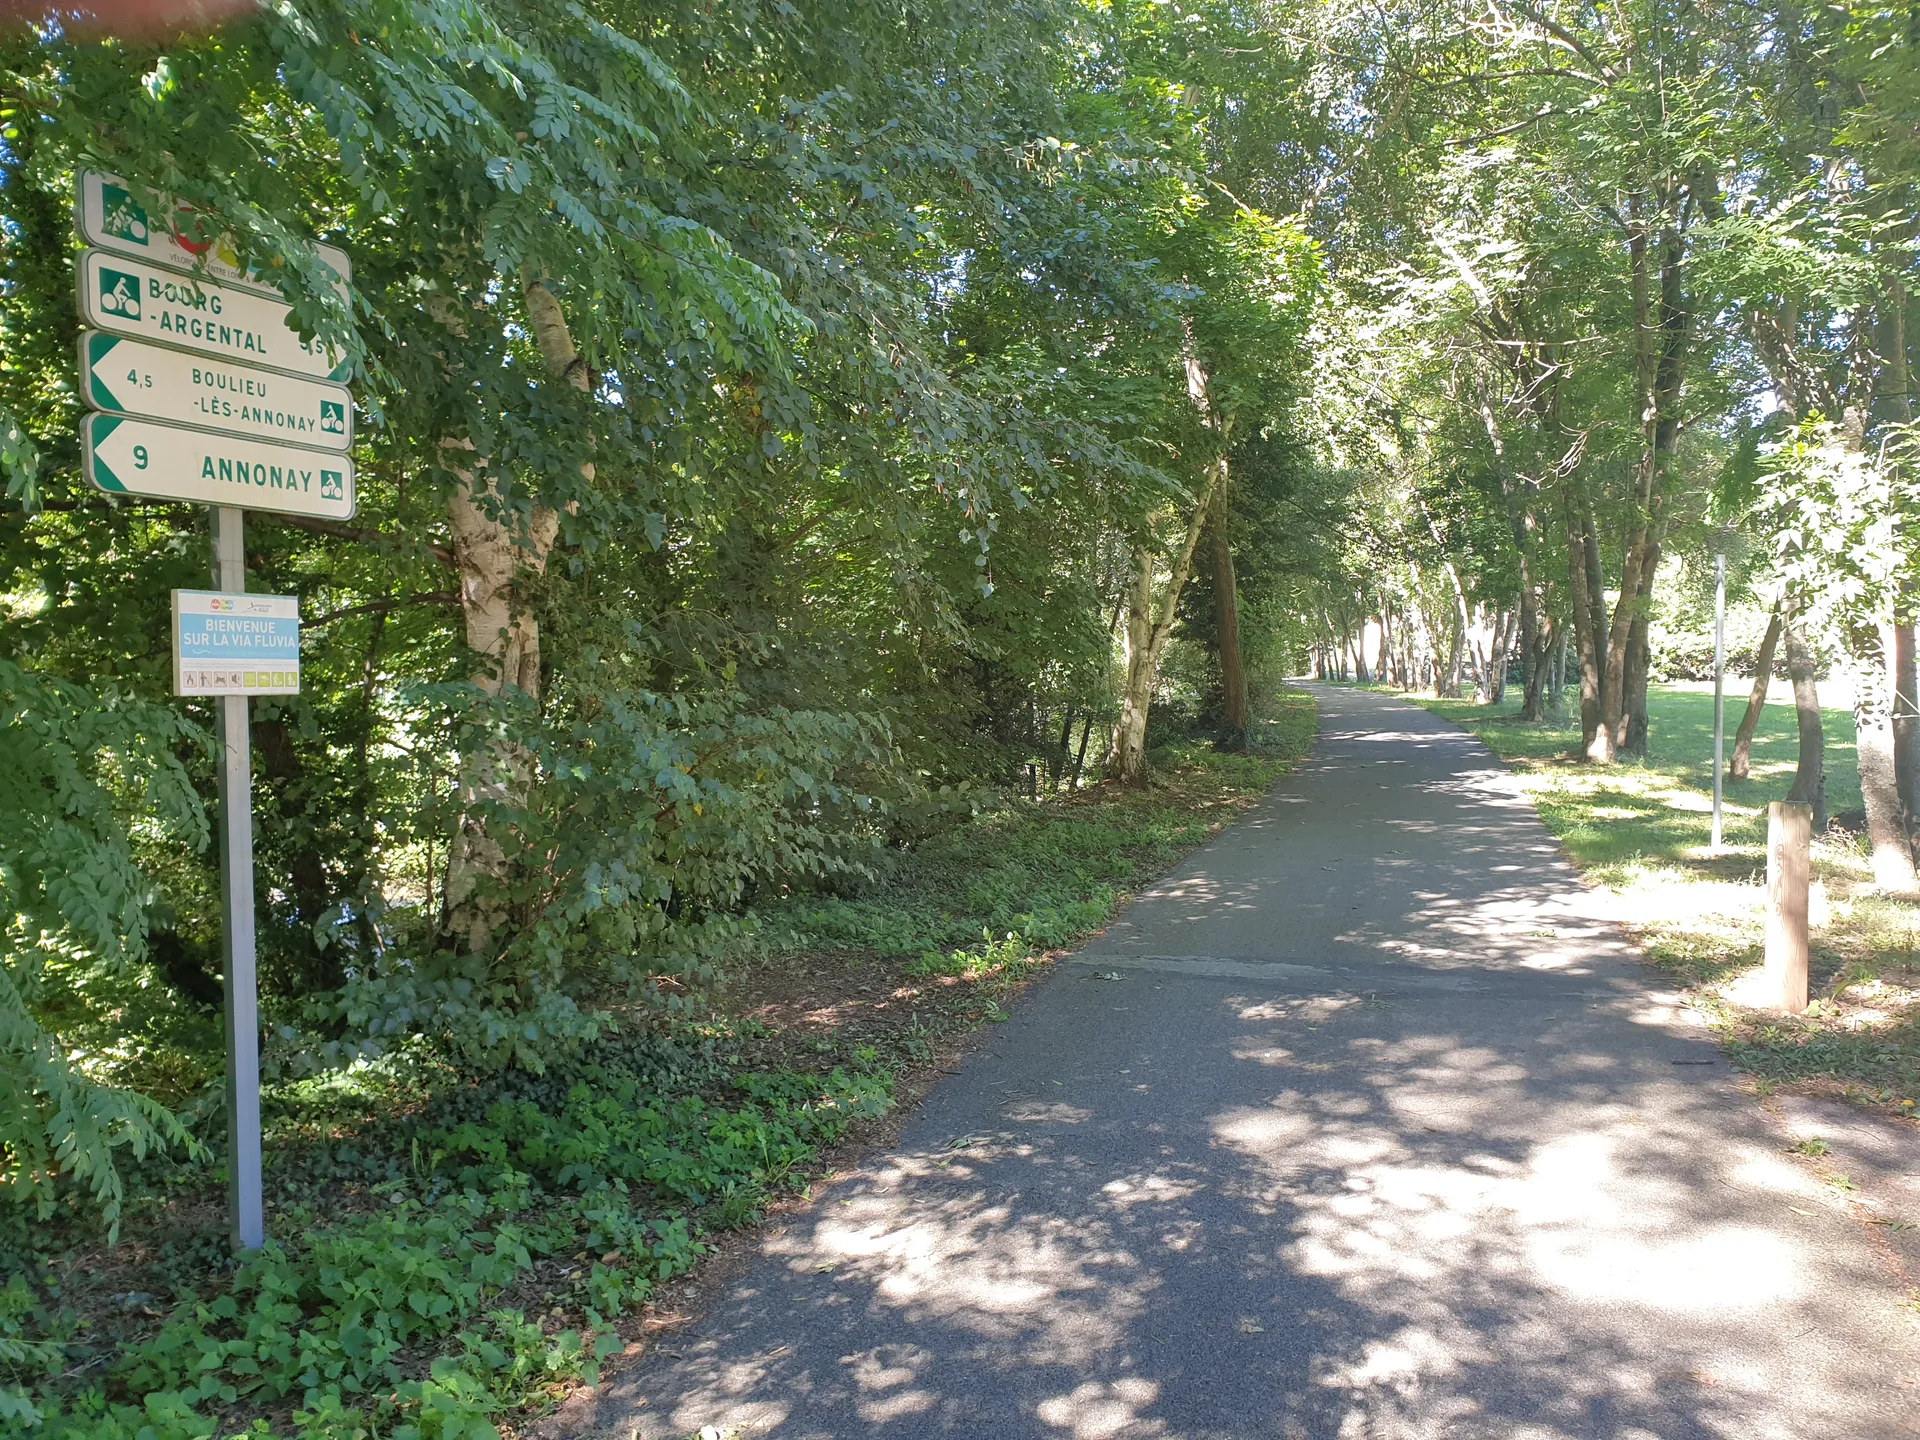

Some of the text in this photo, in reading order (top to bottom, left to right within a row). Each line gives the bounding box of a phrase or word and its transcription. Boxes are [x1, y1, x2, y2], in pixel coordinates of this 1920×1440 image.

[207, 264, 226, 277] ENTRE
[149, 277, 222, 315] BOURG
[150, 310, 267, 354] -ARGENTAL
[126, 368, 152, 389] 4,5
[192, 368, 267, 398] BOULIEU
[193, 397, 316, 433] -LÈS-ANNONAY
[132, 444, 149, 470] 9
[201, 455, 313, 493] ANNONAY
[183, 632, 296, 648] SUR LA VIA FLUVIA
[205, 618, 276, 634] BIENVENUE
